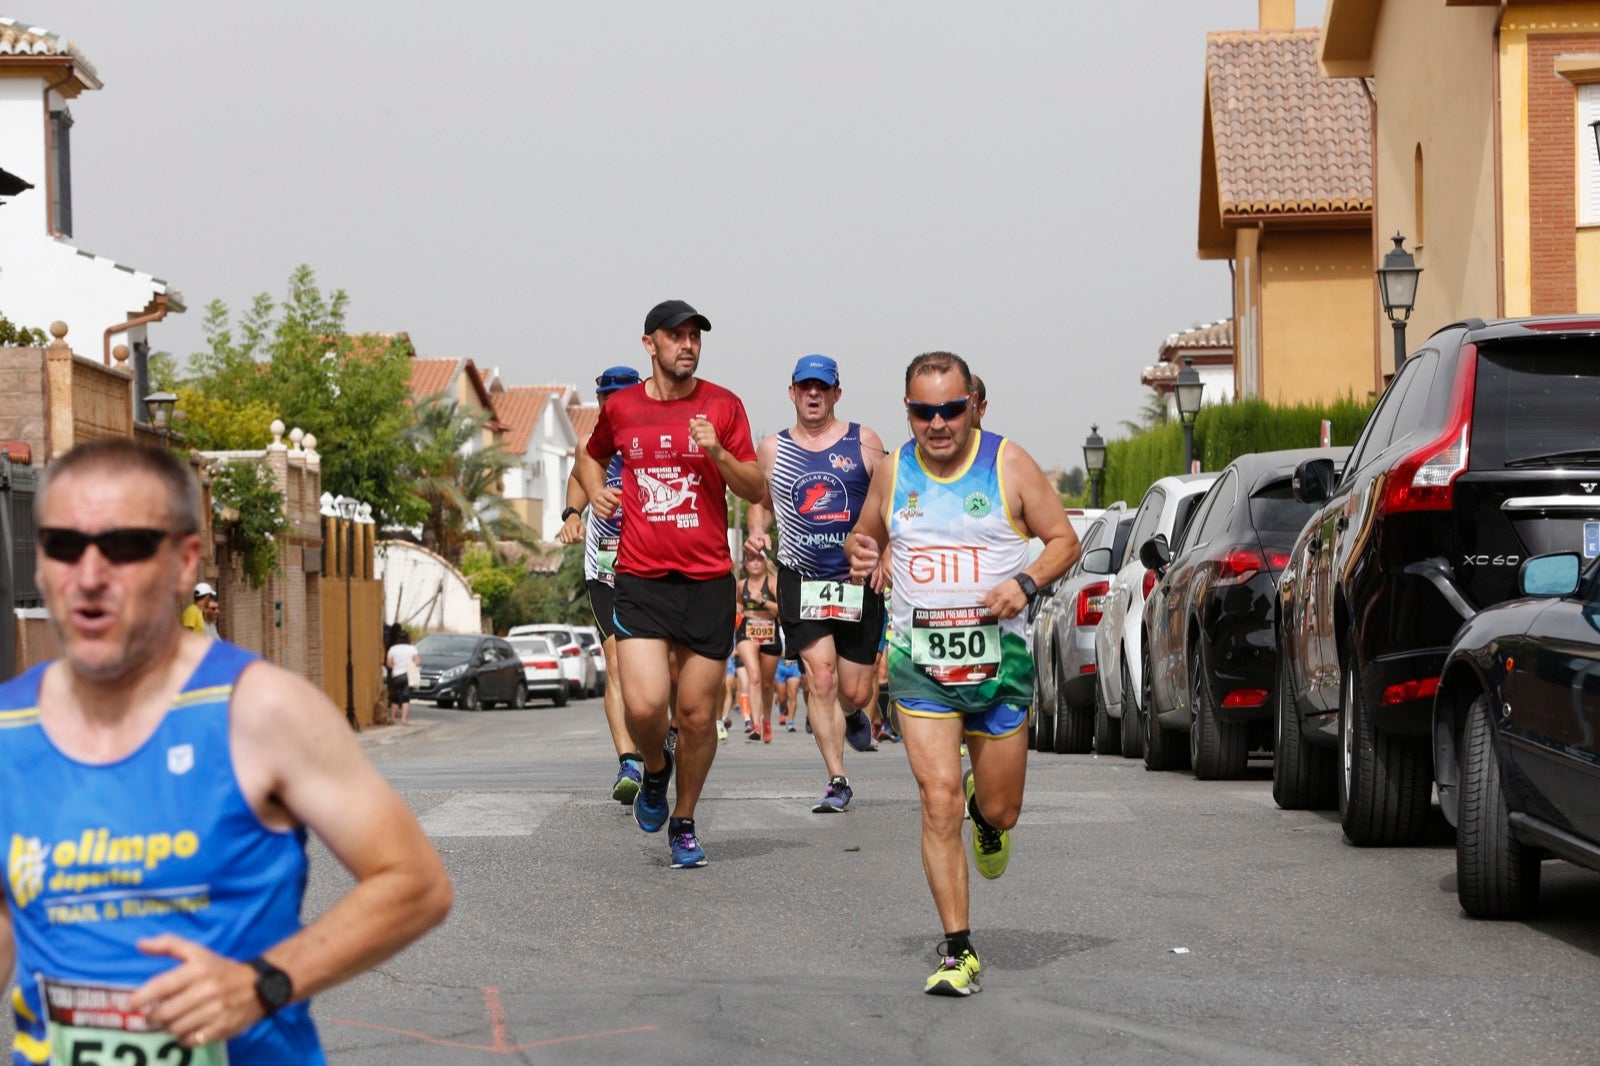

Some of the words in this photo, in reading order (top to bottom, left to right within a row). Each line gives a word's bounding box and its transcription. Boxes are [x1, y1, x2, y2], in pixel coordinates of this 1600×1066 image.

[819, 583, 845, 602] 41
[929, 609, 945, 620] GRAN
[945, 608, 967, 619] PREMIO
[968, 608, 976, 618] DE
[750, 627, 773, 637] 2093
[928, 630, 986, 659] 850
[52, 827, 199, 870] olimpo
[49, 869, 143, 891] deportes
[47, 903, 99, 924] TRAIL
